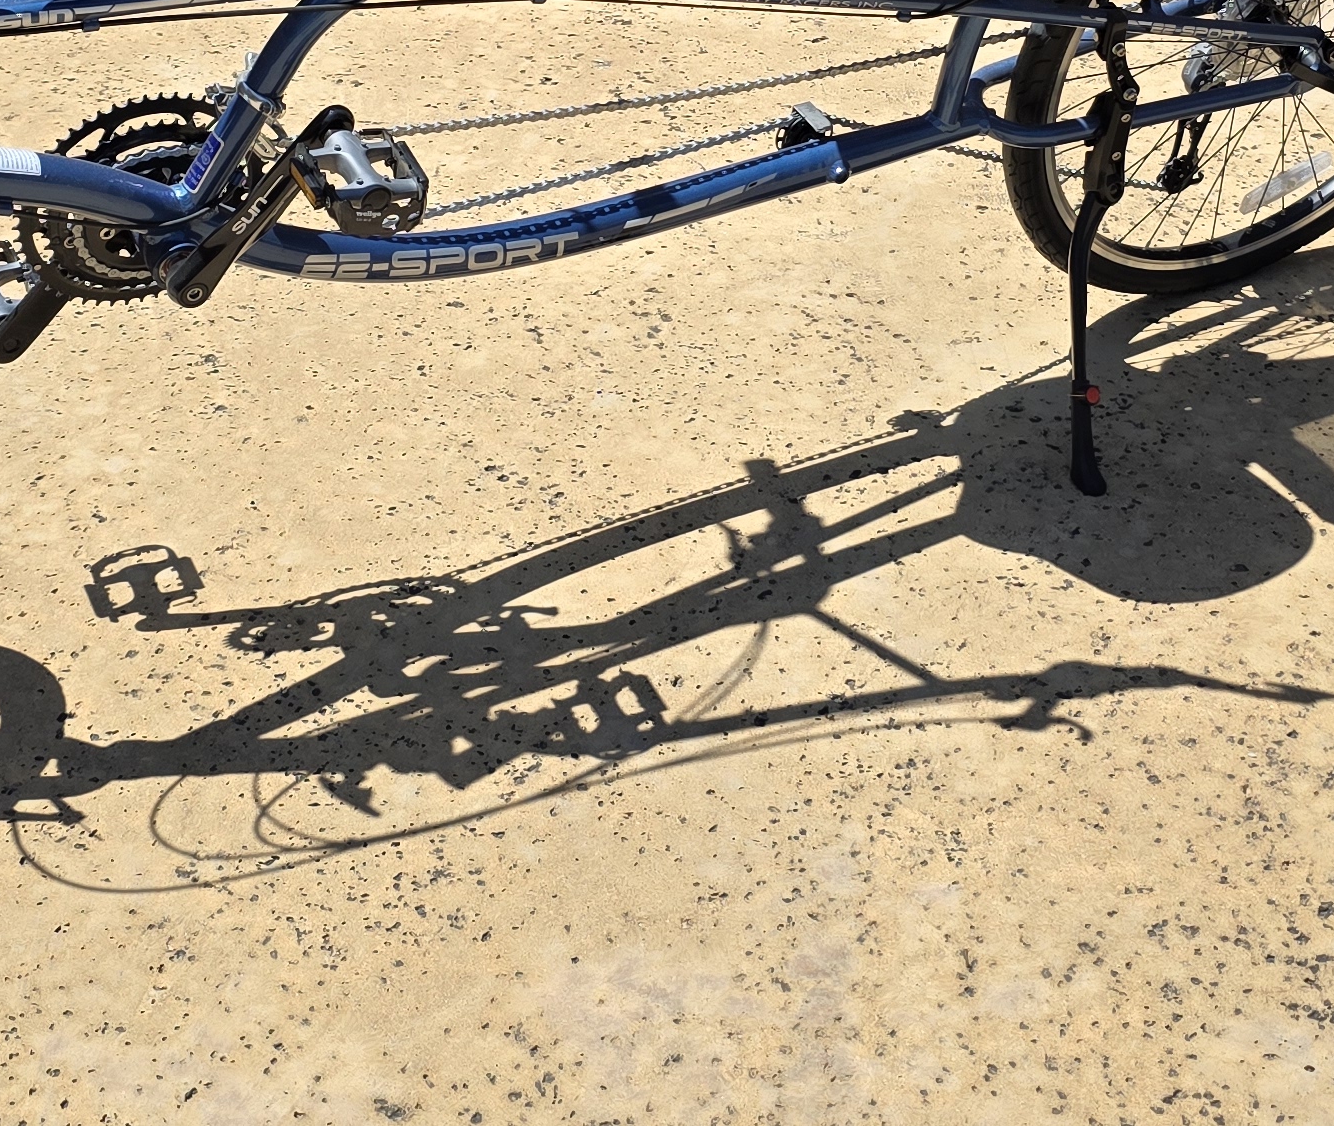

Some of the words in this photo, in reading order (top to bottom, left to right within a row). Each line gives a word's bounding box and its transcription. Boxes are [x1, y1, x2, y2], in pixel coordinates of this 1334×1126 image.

[1150, 22, 1248, 41] EZ-SPORT
[231, 196, 268, 235] sun
[299, 231, 579, 280] EZ-SPORT
